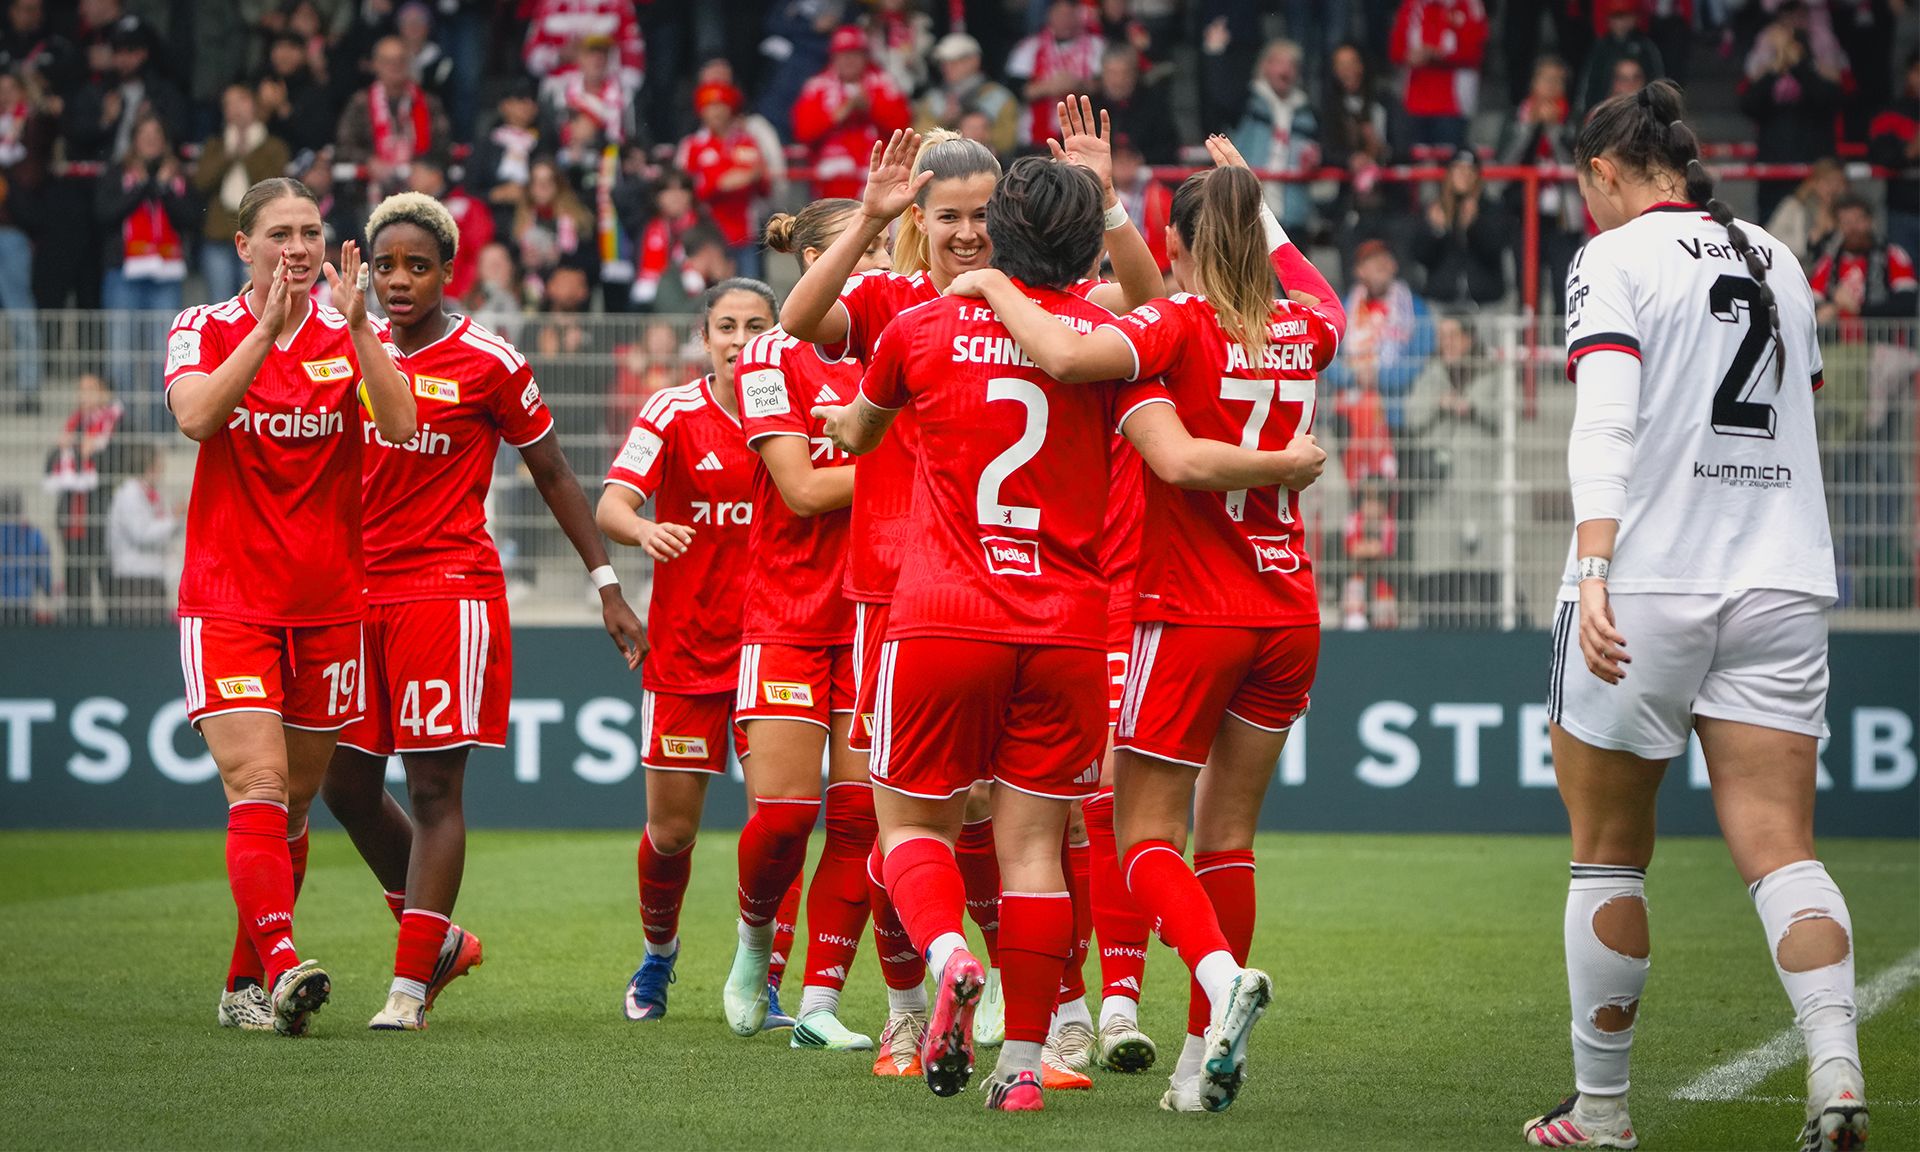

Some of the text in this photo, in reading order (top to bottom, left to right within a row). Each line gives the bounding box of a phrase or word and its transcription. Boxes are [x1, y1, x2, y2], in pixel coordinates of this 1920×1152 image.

[973, 307, 992, 322] FC
[1271, 320, 1308, 338] BERLIN
[1709, 273, 1777, 440] 2
[746, 382, 784, 397] Google
[755, 395, 779, 409] Pixel
[253, 405, 344, 438] raisin
[976, 377, 1049, 531] 2
[1219, 377, 1317, 524] 77
[1693, 461, 1792, 481] kummich
[991, 546, 1031, 564] bella
[322, 658, 358, 717] 19
[791, 692, 809, 701] UNION
[400, 678, 453, 737] 42
